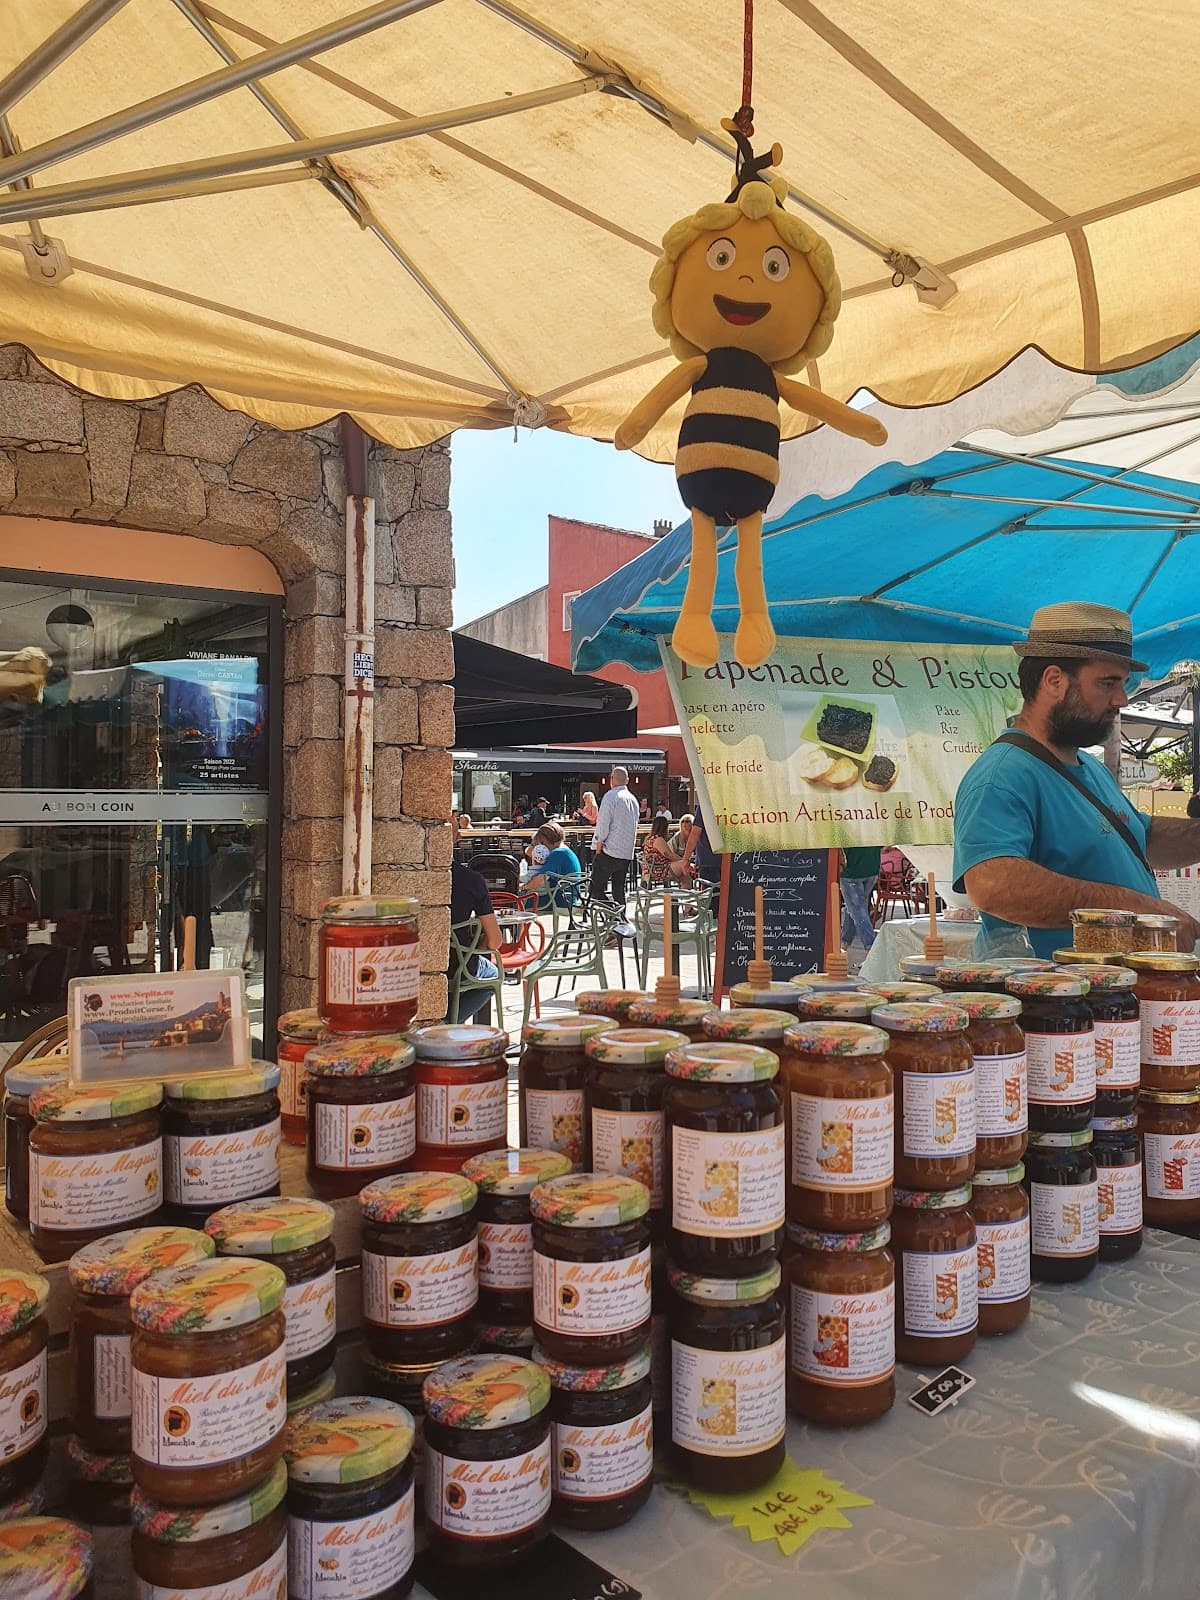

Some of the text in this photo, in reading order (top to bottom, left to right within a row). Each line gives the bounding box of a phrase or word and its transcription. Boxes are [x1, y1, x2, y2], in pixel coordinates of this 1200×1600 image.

[872, 655, 907, 688] &
[712, 704, 727, 712] en
[731, 700, 766, 715] apéro
[934, 704, 961, 717] Pâte
[940, 721, 959, 736] Riz
[726, 760, 763, 776] froide
[101, 803, 134, 812] COIN
[794, 801, 889, 823] Artisanale
[893, 801, 913, 821] de
[183, 1139, 224, 1157] Miel
[224, 1138, 243, 1154] du
[41, 1160, 80, 1178] Miel
[81, 1160, 102, 1176] du
[164, 1378, 221, 1404] Miel
[217, 1376, 244, 1399] du
[447, 1463, 493, 1483] Miel
[489, 1464, 511, 1483] du
[752, 1491, 799, 1517] 14€
[816, 1489, 834, 1504] 3
[317, 1517, 387, 1546] Miel du
